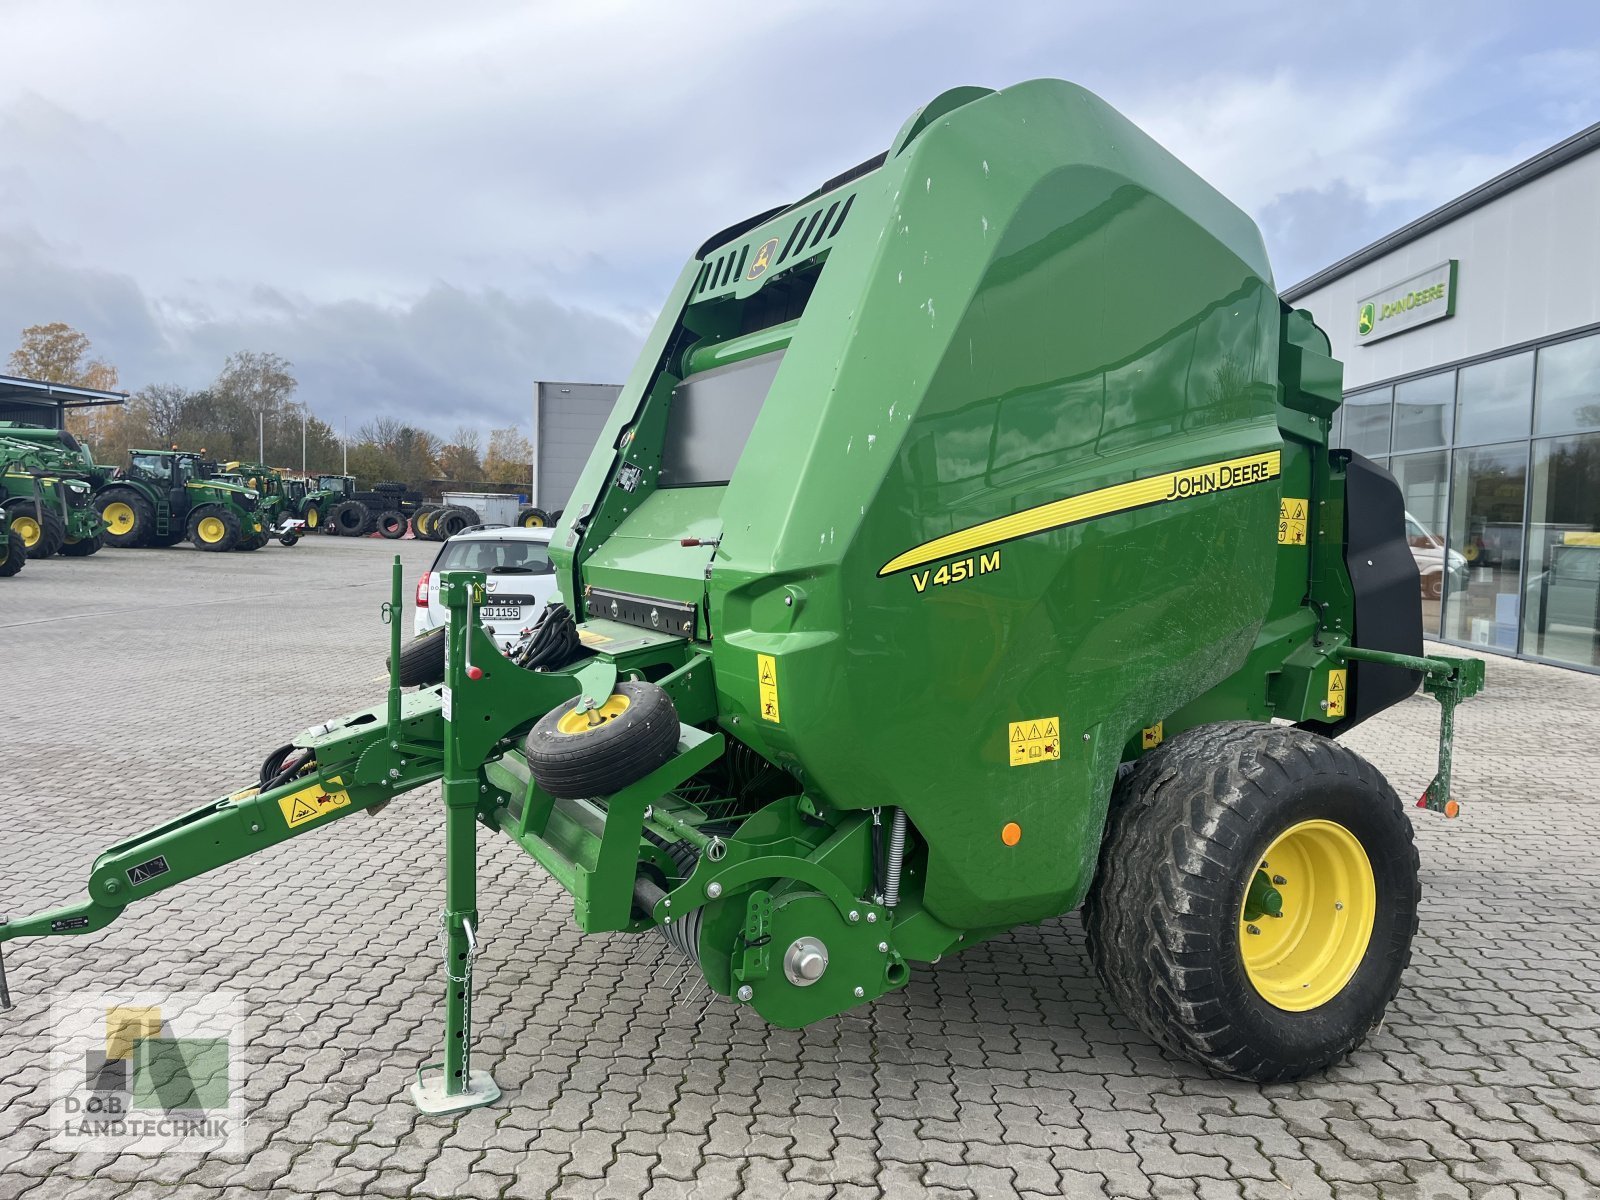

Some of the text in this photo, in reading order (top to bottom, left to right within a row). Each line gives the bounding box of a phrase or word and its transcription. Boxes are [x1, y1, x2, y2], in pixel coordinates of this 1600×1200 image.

[1406, 284, 1445, 310] DEERE
[1166, 461, 1269, 499] JOHN DEERE
[911, 550, 1000, 593] V 451 M
[495, 607, 519, 617] 1155
